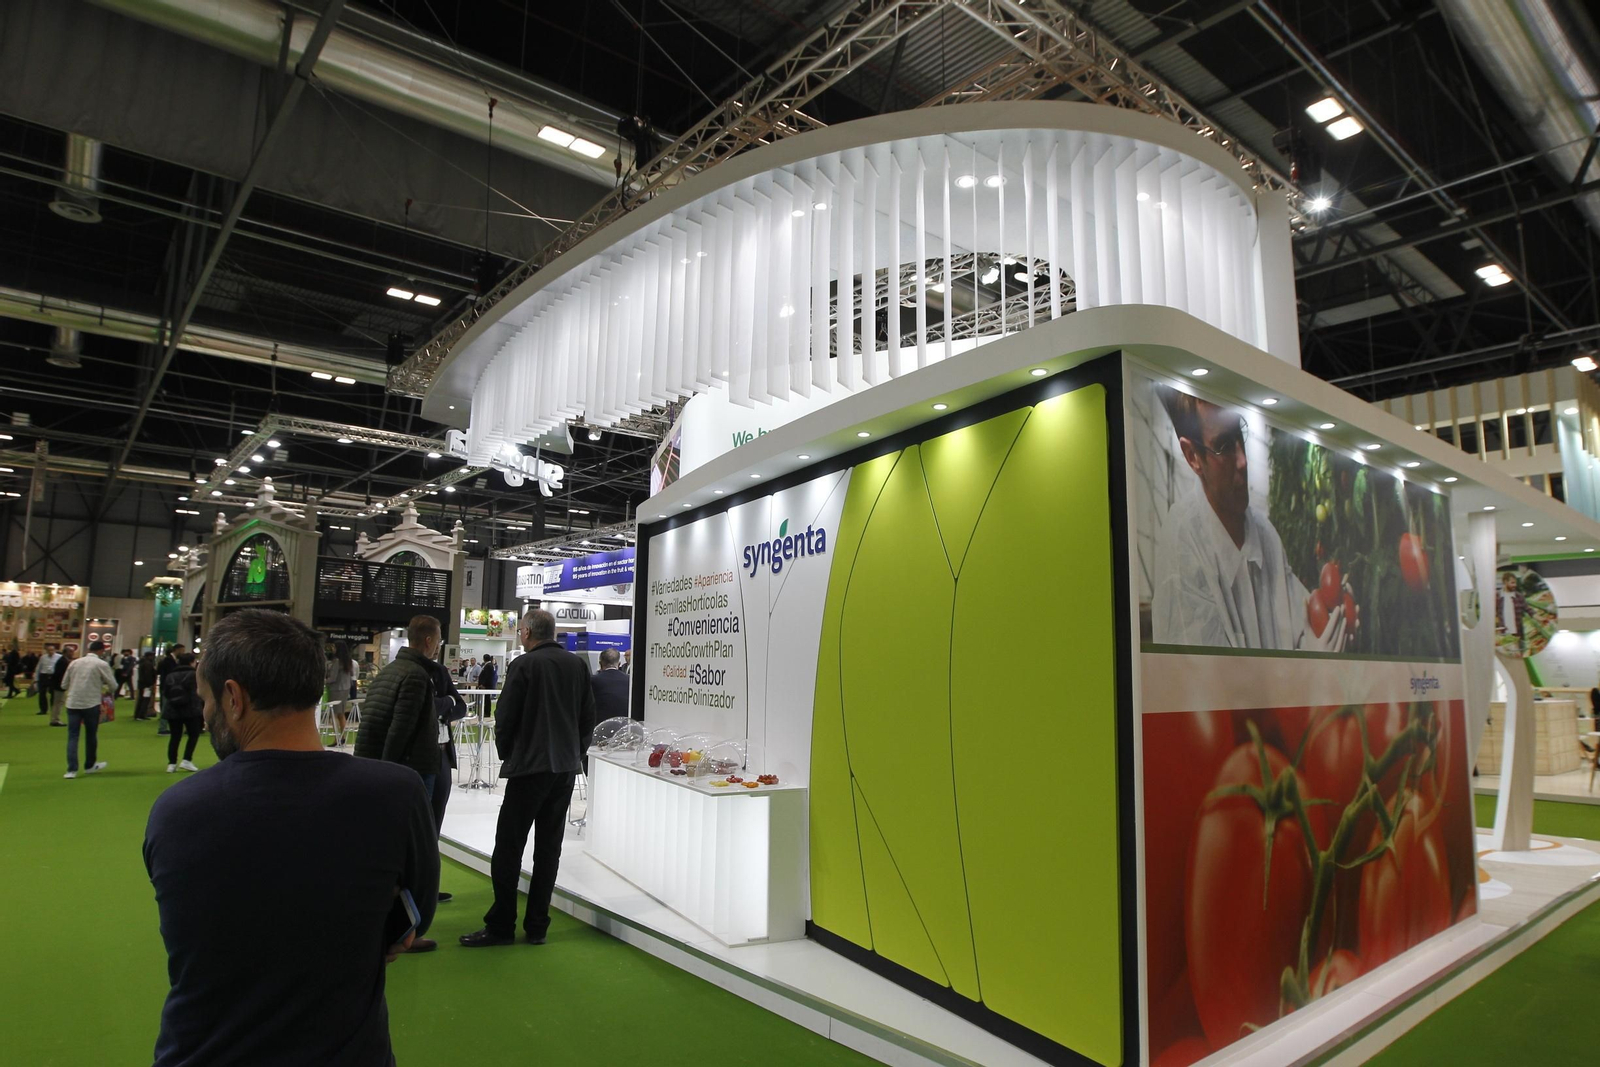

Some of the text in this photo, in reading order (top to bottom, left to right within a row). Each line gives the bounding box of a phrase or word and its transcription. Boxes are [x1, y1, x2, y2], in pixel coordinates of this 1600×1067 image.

[732, 431, 754, 448] We
[743, 524, 827, 578] syngenta
[651, 569, 734, 596] #Variedades #Apariencia
[654, 591, 729, 616] #SemillasHortícolas
[667, 611, 740, 637] #Conveniencia
[650, 640, 734, 658] #TheGoodGrowthPlan
[662, 663, 726, 686] #Calidad #Sabor
[1410, 675, 1439, 695] syngenta
[648, 684, 735, 710] #OperaciónPolinizador
